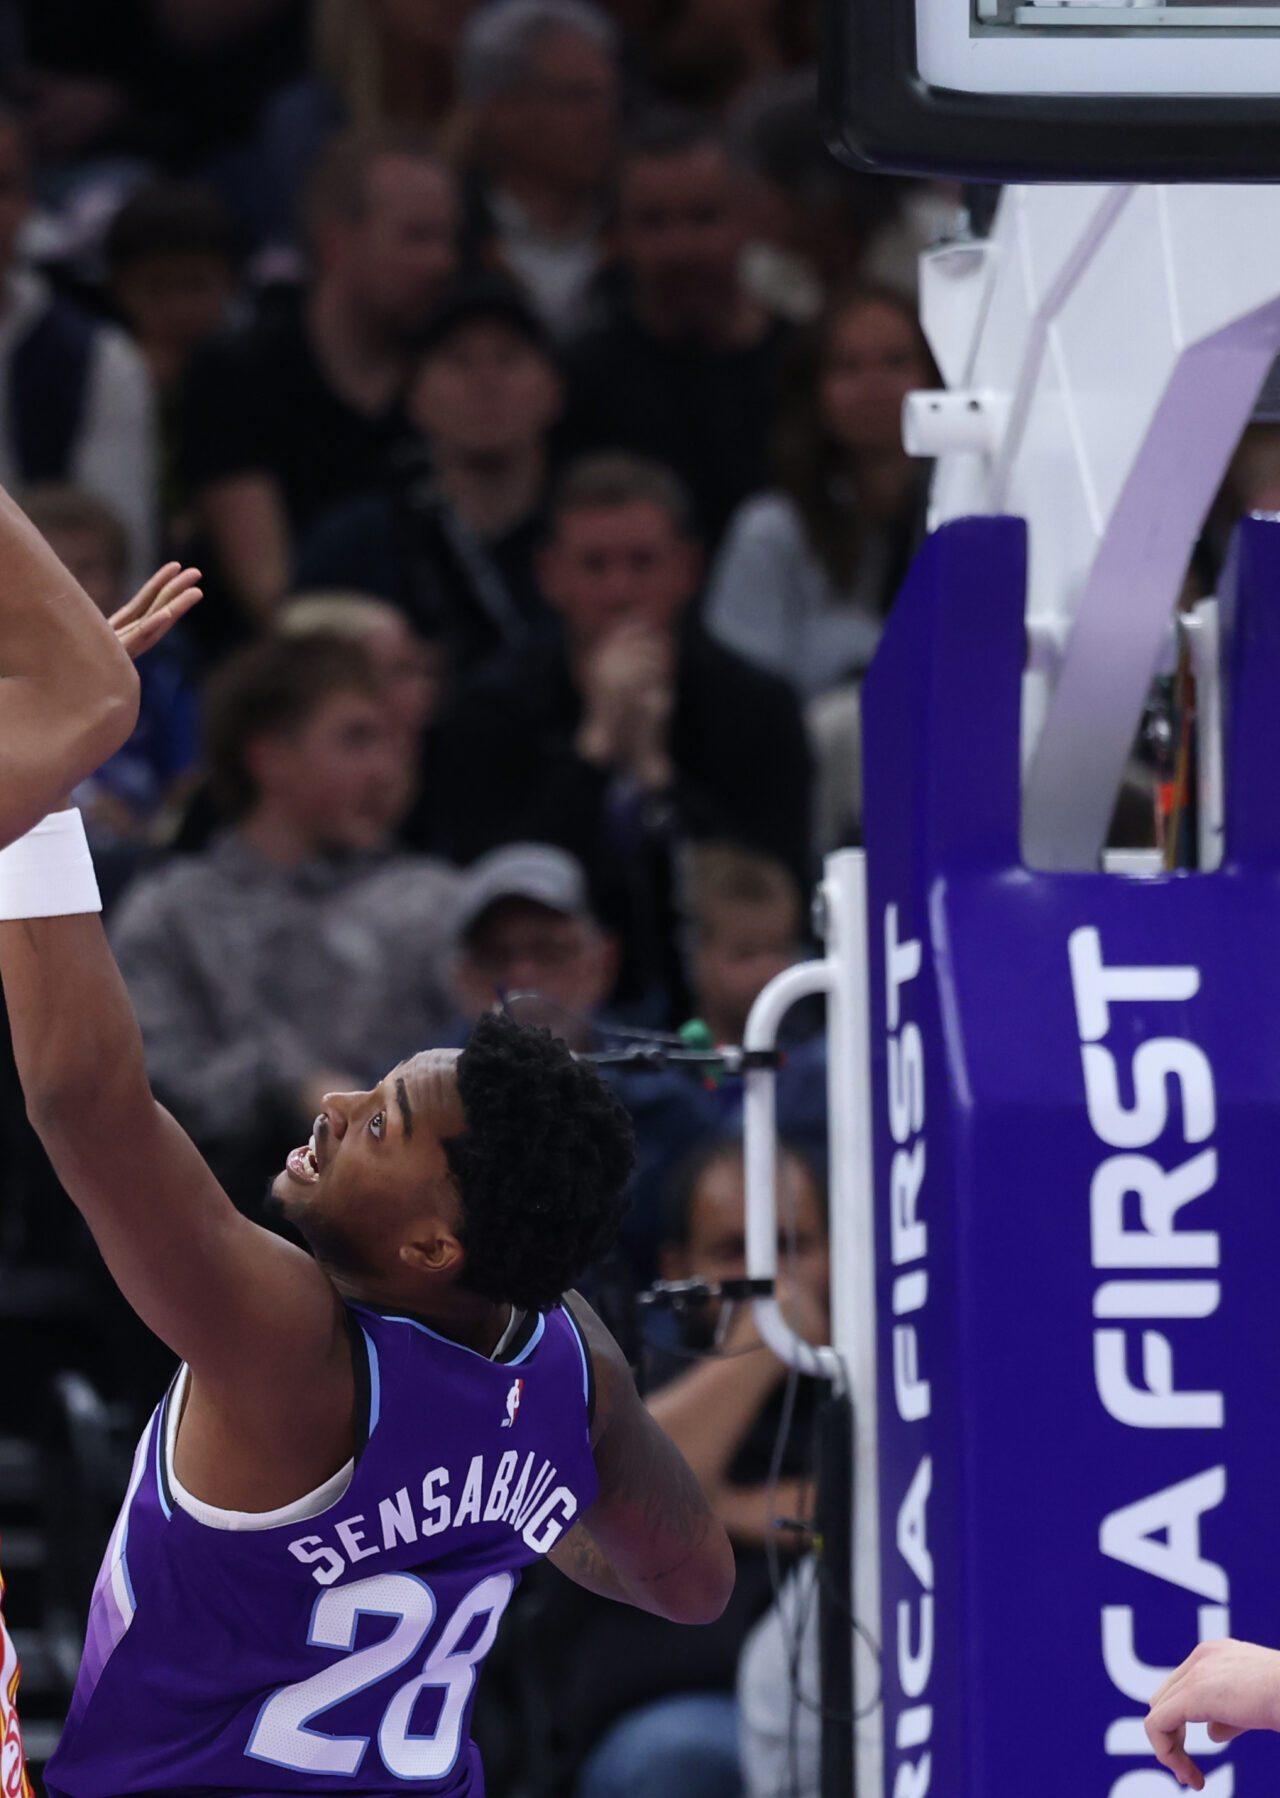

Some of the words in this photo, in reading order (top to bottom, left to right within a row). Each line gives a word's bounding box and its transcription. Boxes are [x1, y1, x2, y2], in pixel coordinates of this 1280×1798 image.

[884, 902, 932, 1423] FIRST
[1067, 925, 1226, 1429] FIRST
[244, 1570, 516, 1781] 28
